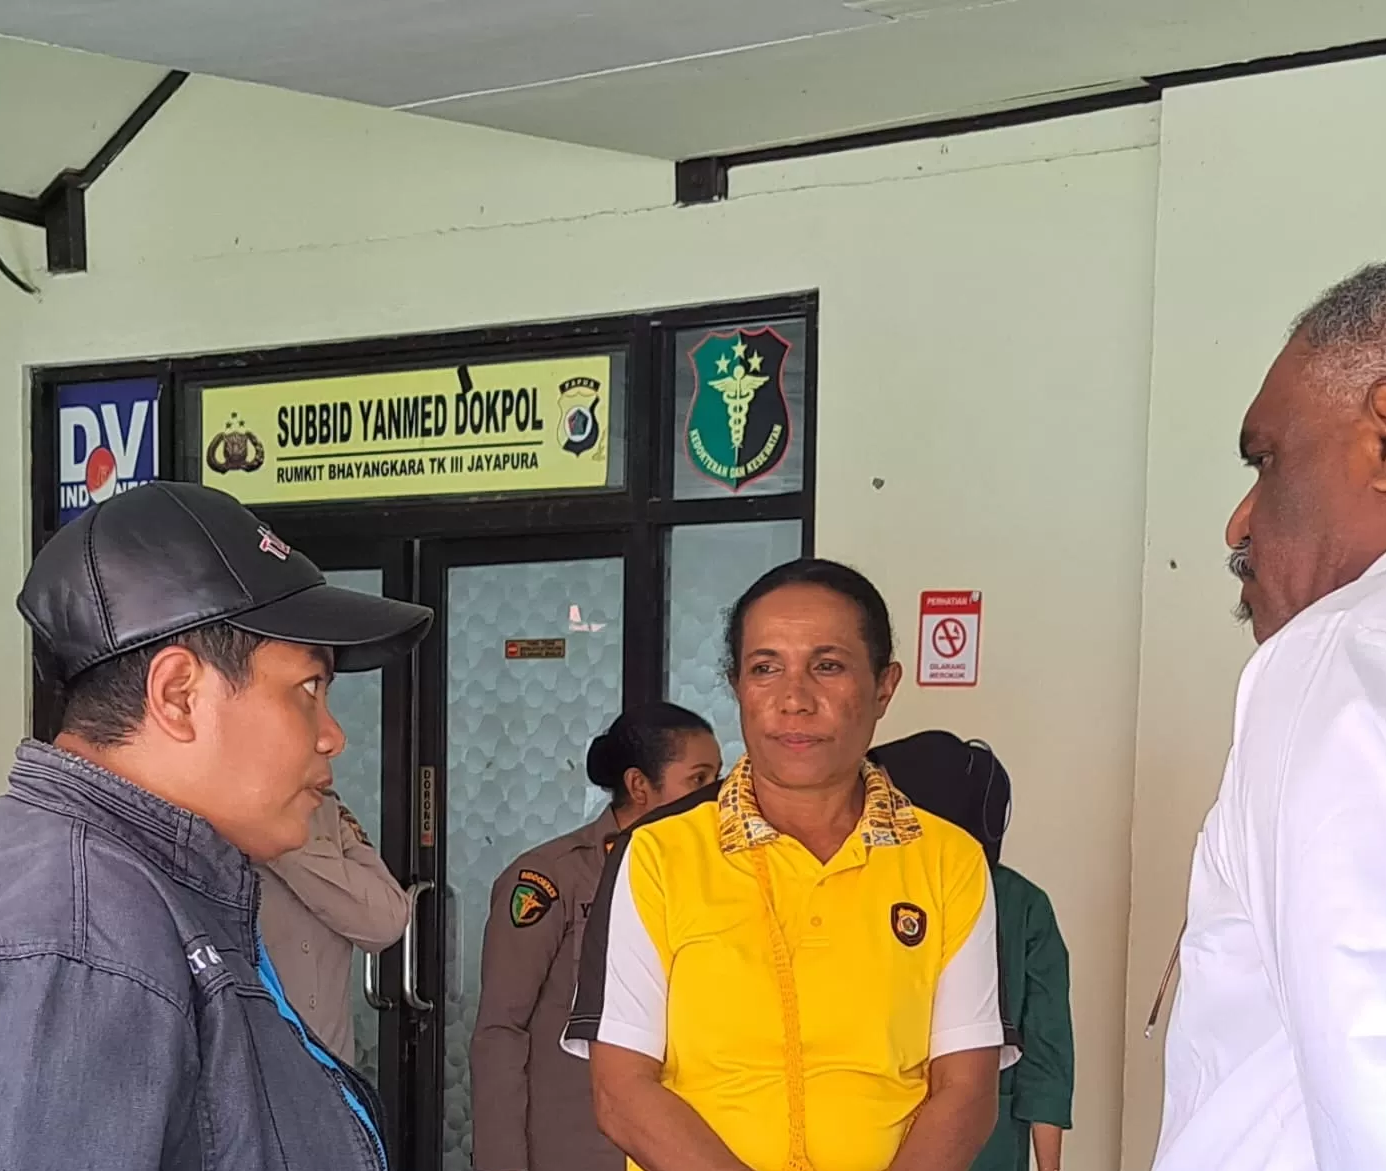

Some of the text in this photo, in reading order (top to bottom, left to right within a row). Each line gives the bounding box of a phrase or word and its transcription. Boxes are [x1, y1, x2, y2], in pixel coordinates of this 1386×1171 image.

[59, 400, 160, 484] DVI
[277, 387, 544, 448] SUBBID YANMED DOKPOL
[276, 451, 539, 484] RUMKIT BHAYANGKARA TK III JAYAPURA
